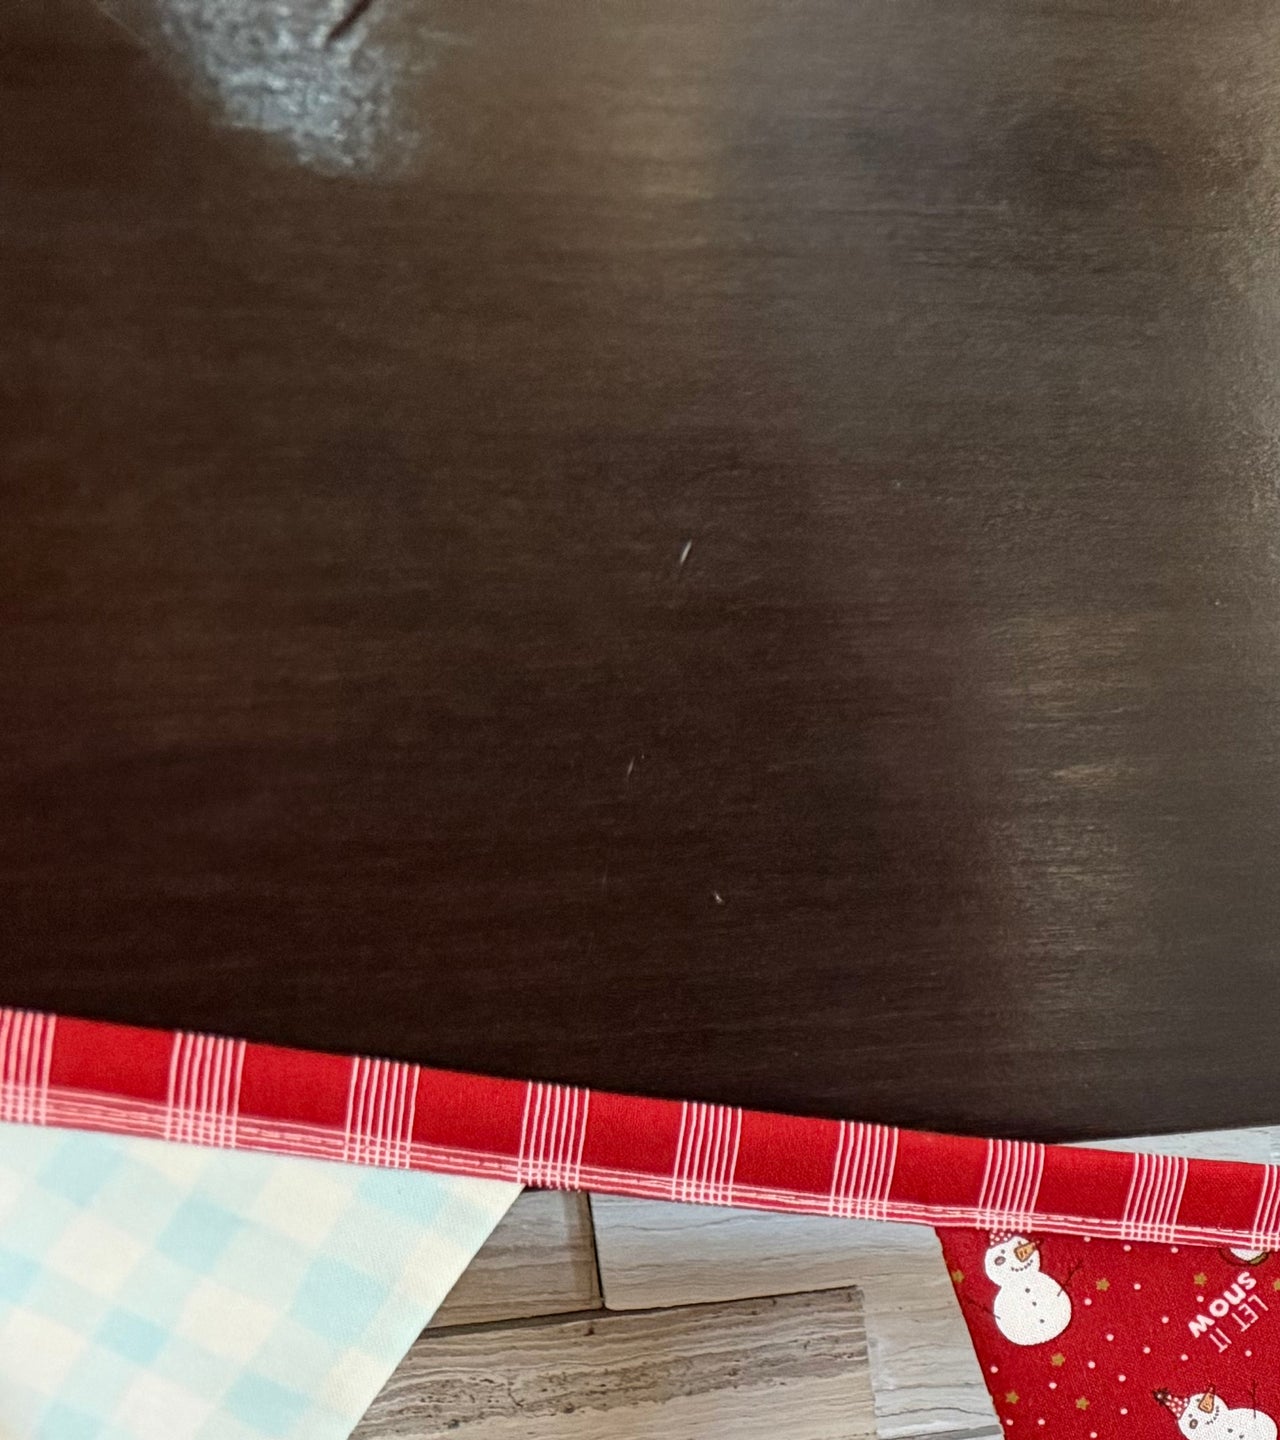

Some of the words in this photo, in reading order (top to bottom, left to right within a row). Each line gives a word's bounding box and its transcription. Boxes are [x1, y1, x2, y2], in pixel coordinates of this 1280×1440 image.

[1188, 1271, 1257, 1338] snow
[1231, 1294, 1269, 1333] LET
[1209, 1327, 1233, 1353] IT
